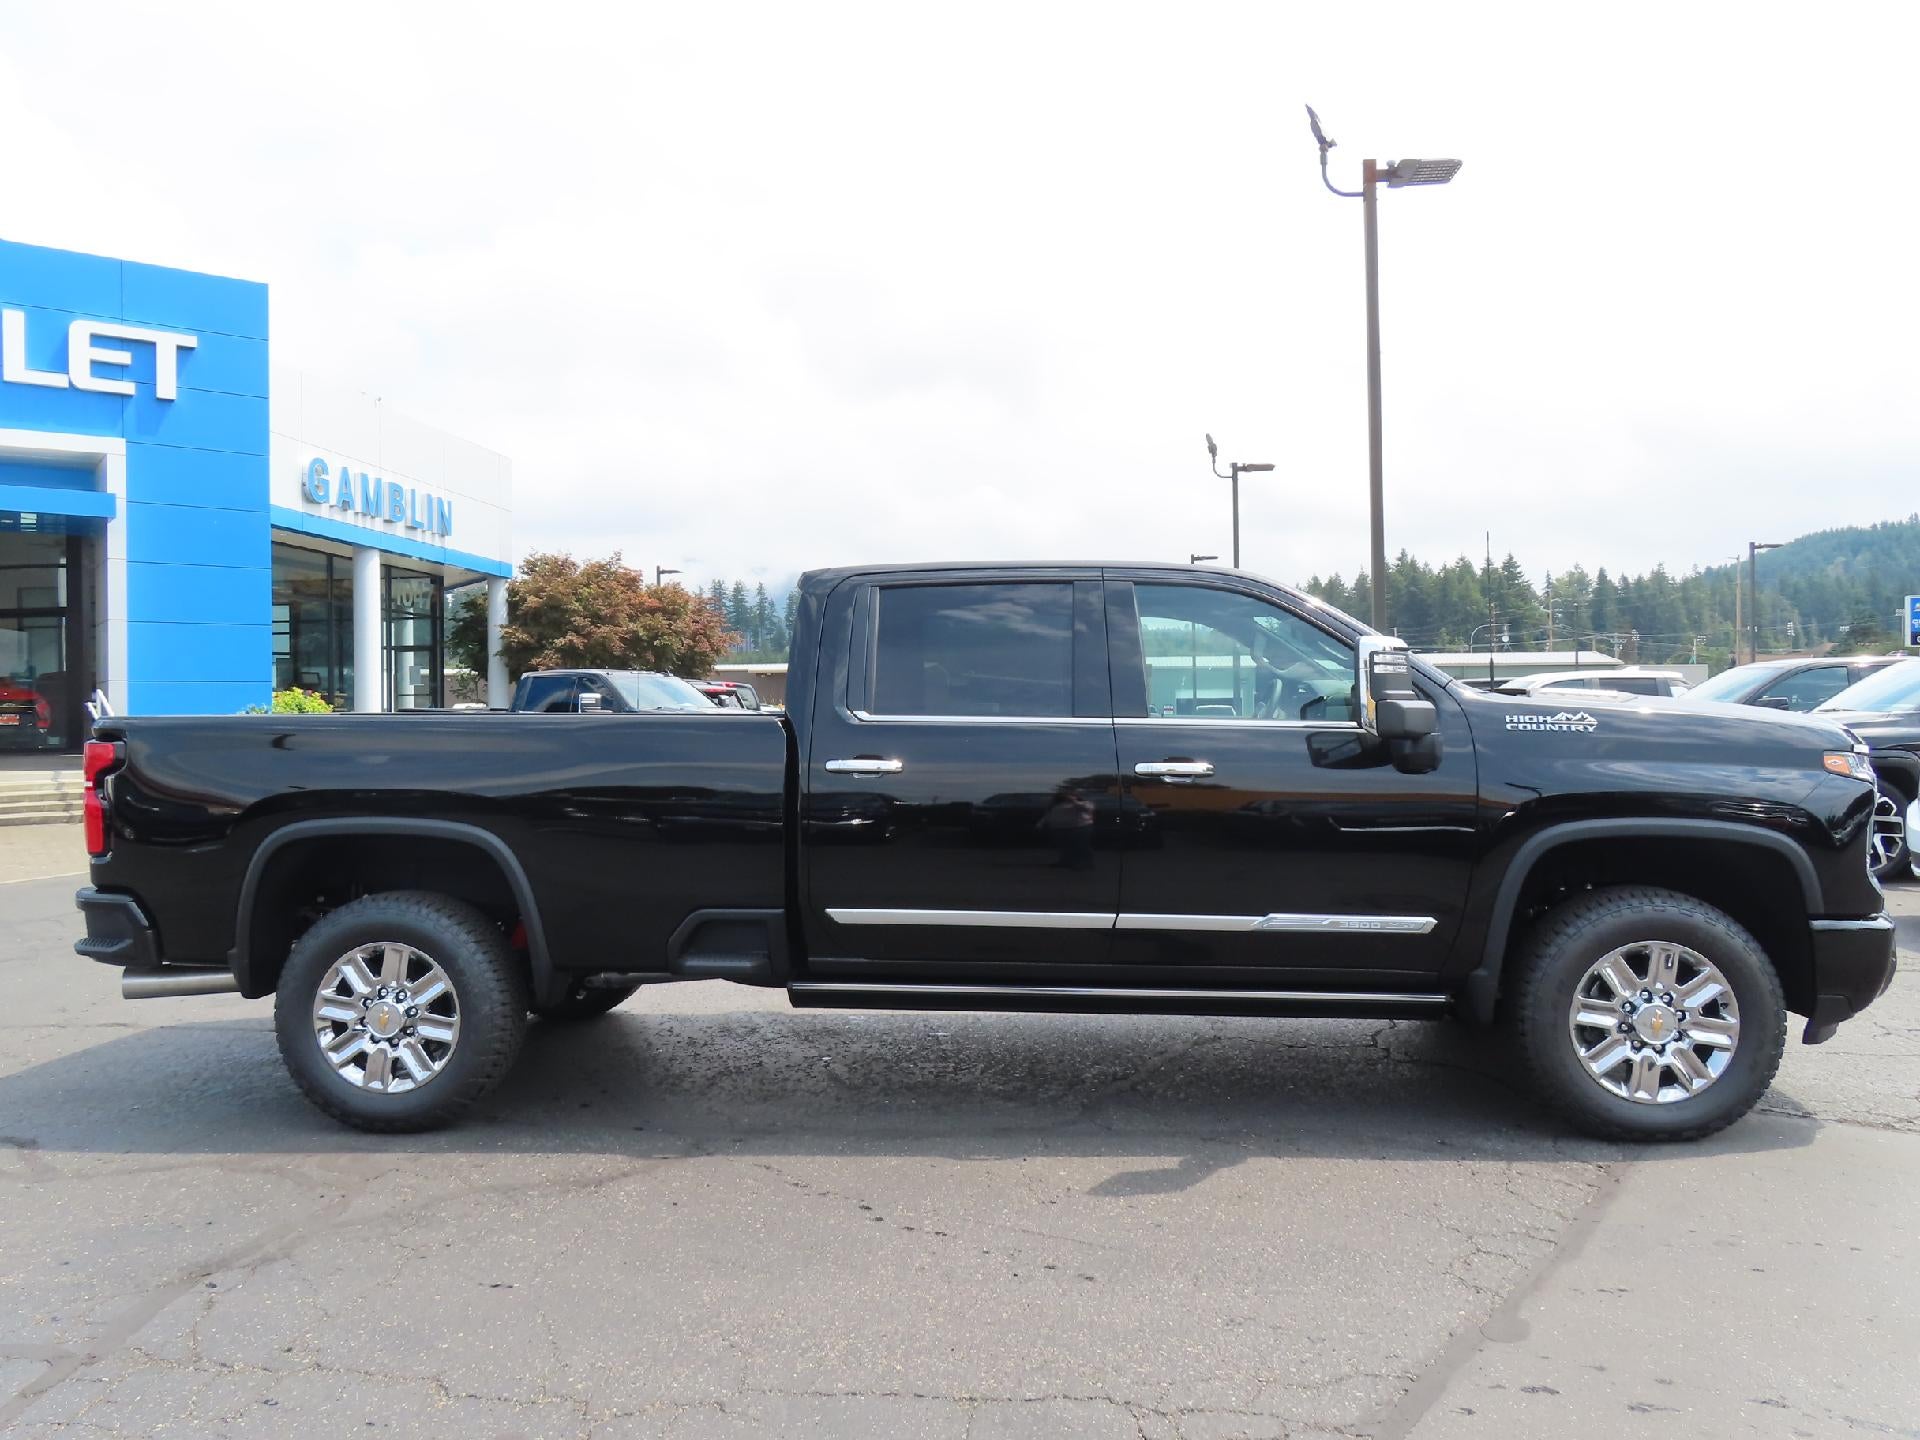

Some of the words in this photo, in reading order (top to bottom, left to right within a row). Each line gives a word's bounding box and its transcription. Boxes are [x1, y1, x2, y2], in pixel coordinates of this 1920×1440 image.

[2, 308, 198, 401] LET
[302, 457, 453, 537] GAMBLIN
[1505, 715, 1551, 723] HIGH
[1505, 723, 1596, 732] COUNTRY
[1339, 920, 1381, 929] 3500
